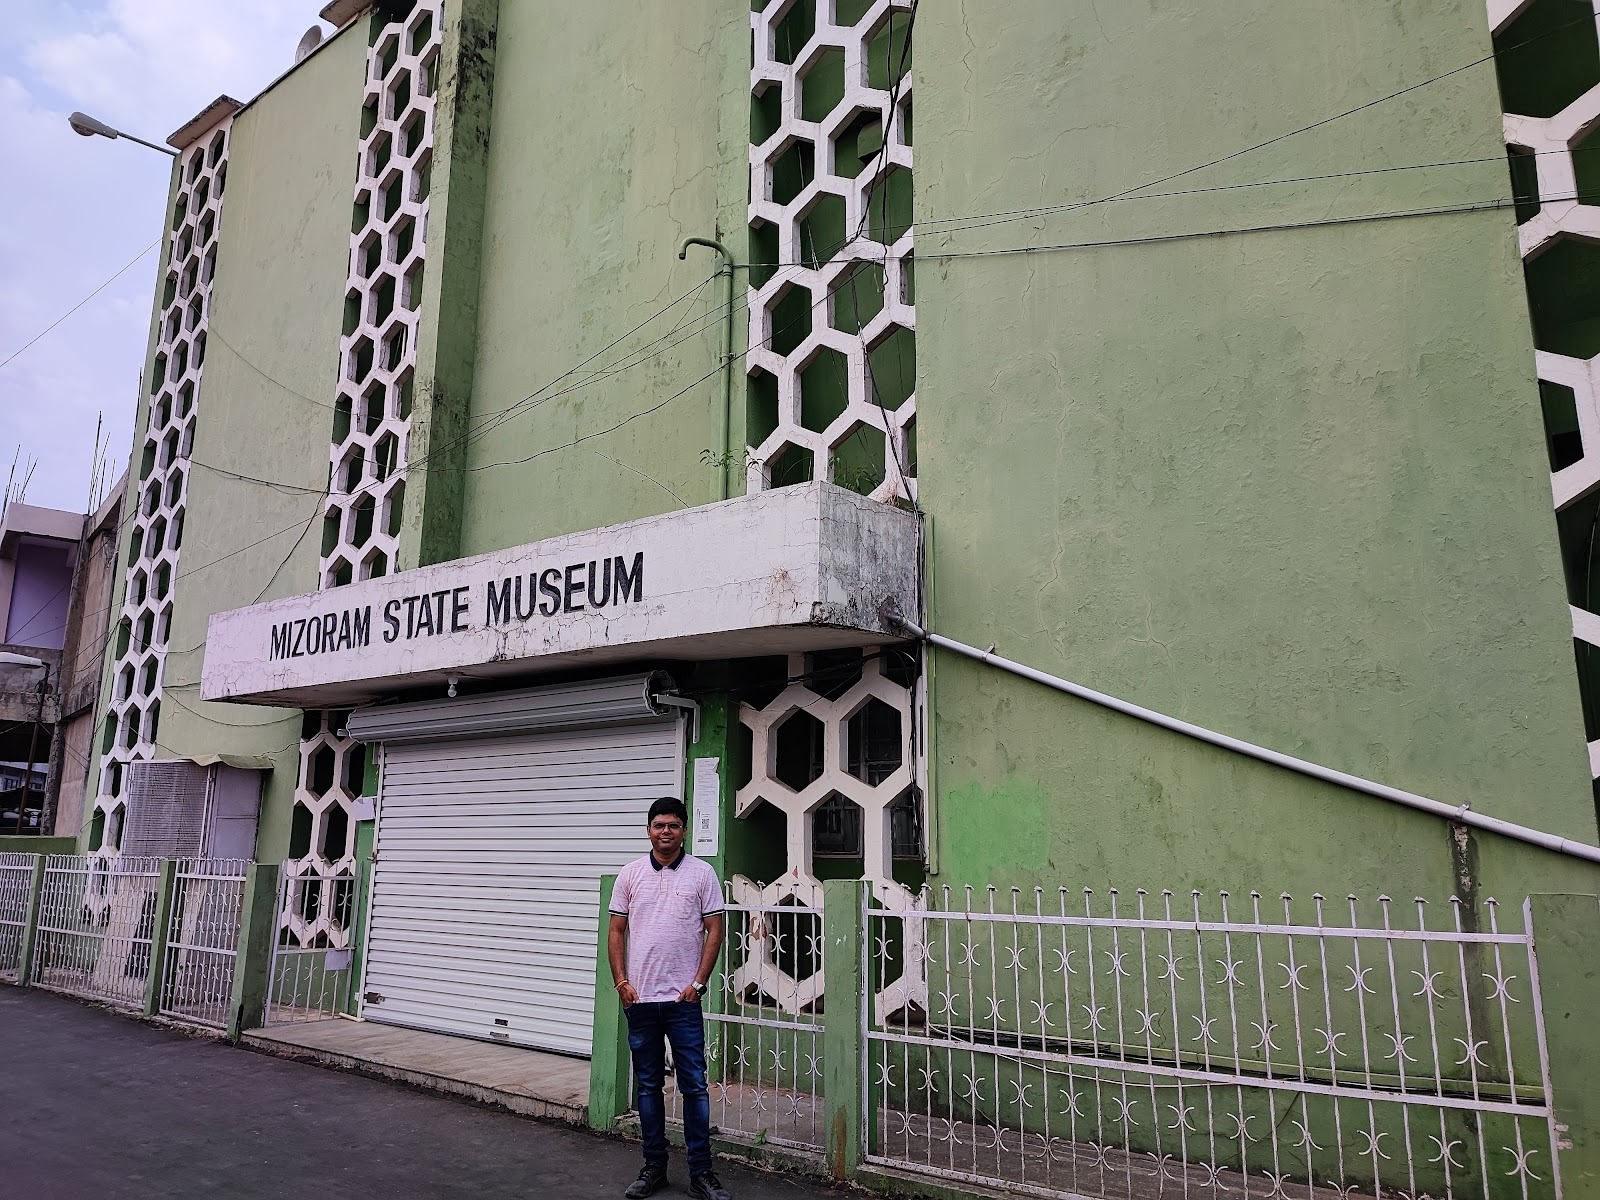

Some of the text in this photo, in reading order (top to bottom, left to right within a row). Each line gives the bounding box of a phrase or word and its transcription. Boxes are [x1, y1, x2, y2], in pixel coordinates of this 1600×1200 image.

[269, 552, 643, 662] MIZORAM STATE MUSEUM
